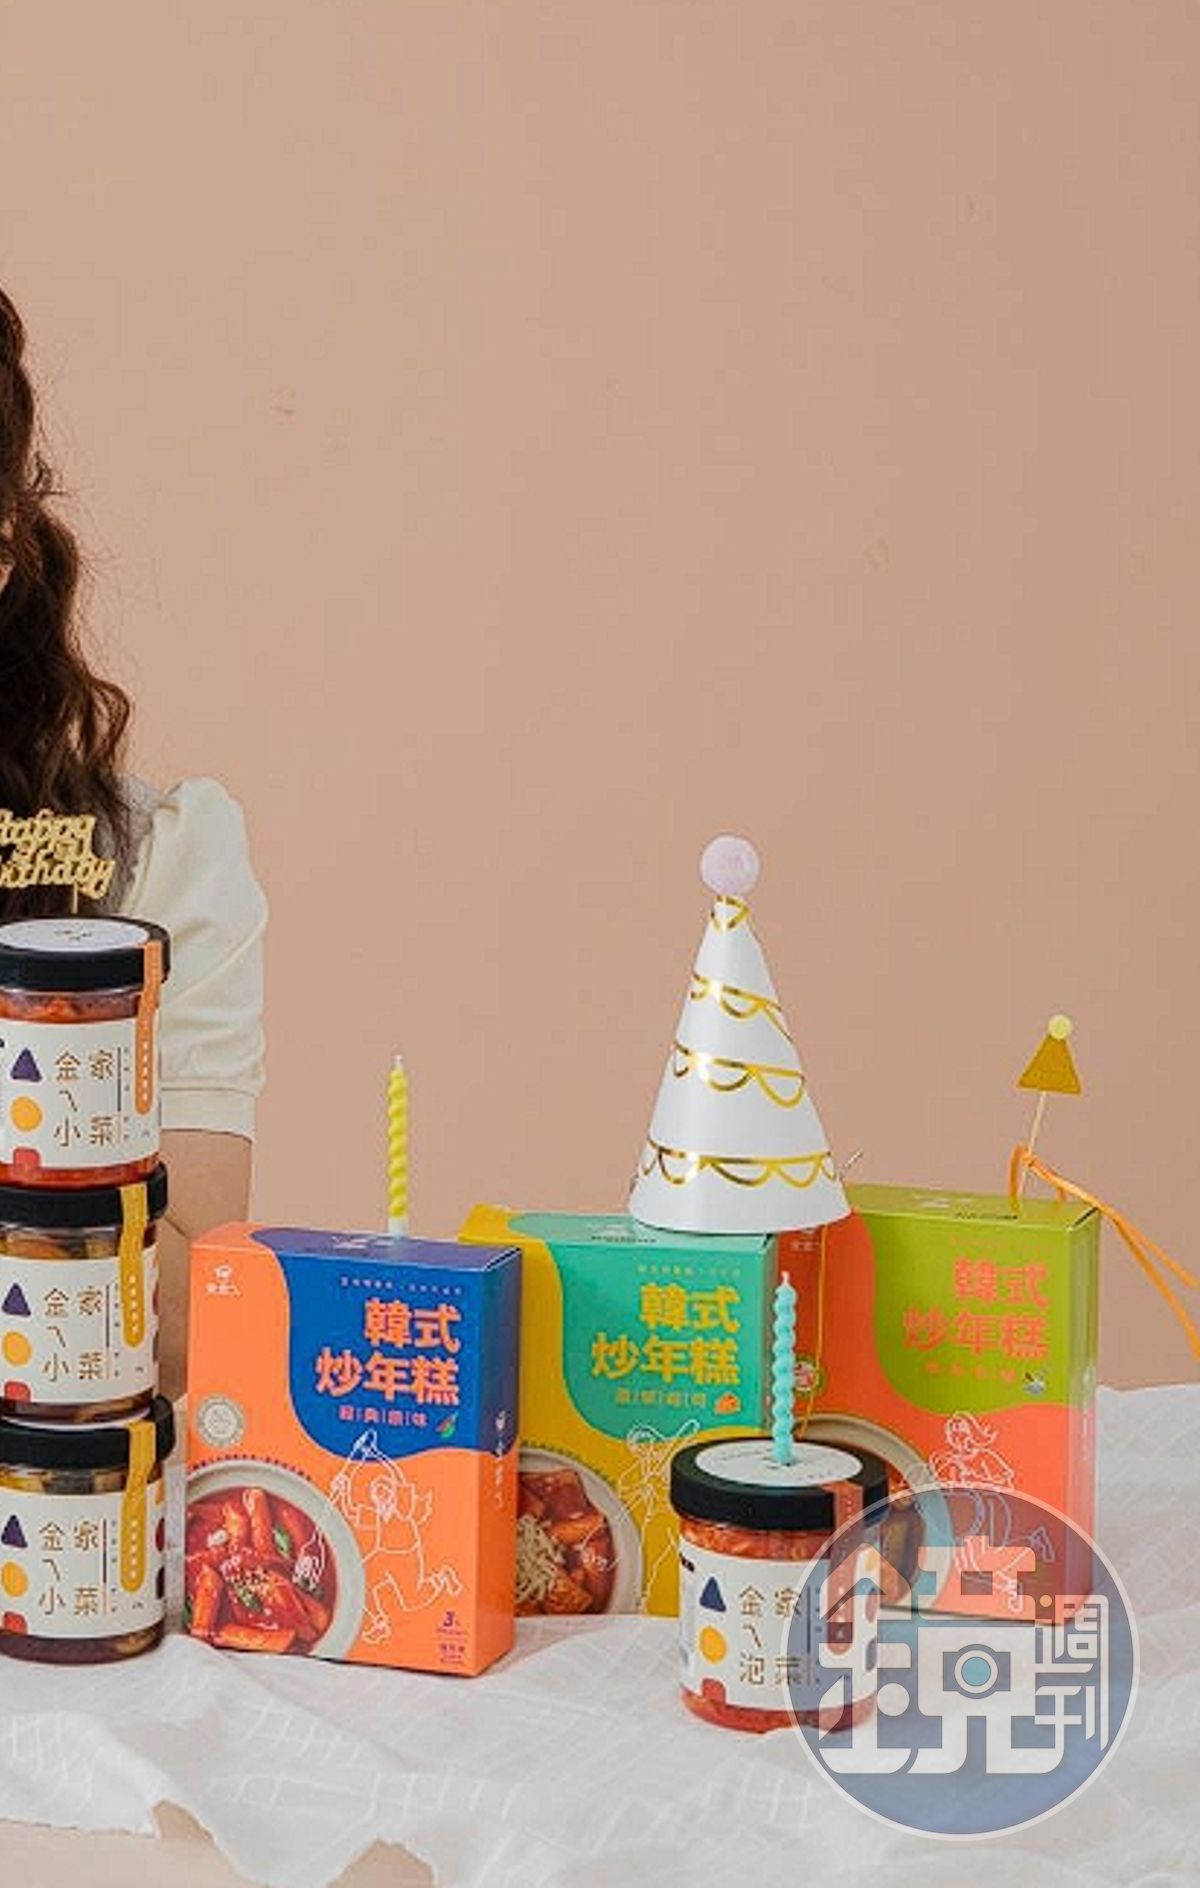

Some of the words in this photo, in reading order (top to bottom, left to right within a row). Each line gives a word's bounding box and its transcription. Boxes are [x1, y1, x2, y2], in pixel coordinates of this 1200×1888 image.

[55, 1049, 113, 1083] 金家
[44, 1285, 102, 1317] 金家
[640, 1282, 742, 1333] 韓式
[953, 1256, 1050, 1309] 韓式
[364, 1297, 462, 1353] 韓式
[902, 1304, 1050, 1359] 炒年糕
[315, 1347, 460, 1406] 炒年糕
[591, 1332, 741, 1384] 炒年糕
[39, 1520, 99, 1551] 金家
